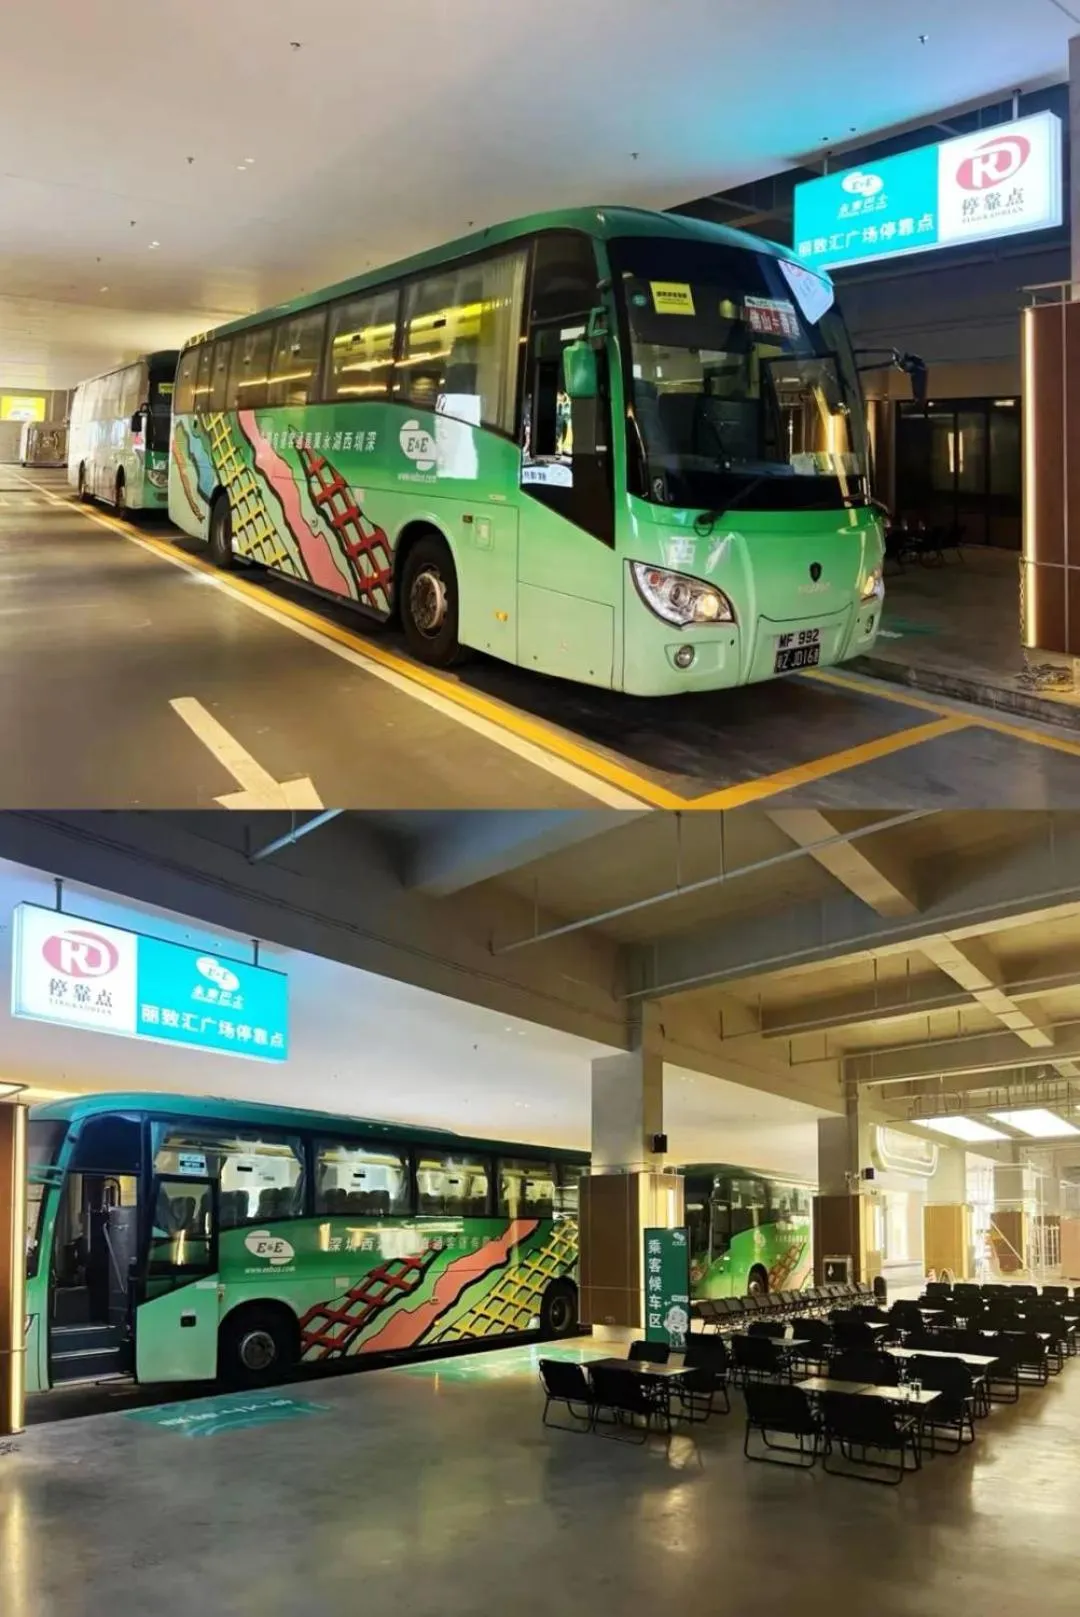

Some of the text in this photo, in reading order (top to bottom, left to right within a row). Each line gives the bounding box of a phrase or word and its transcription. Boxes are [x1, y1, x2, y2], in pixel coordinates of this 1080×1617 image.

[962, 187, 1024, 216] 停靠点
[798, 213, 934, 257] 丽致汇广场停靠点
[798, 628, 820, 645] 992
[49, 978, 113, 1008] 停靠点
[141, 1003, 284, 1048] 丽致汇广场停靠点
[648, 1238, 662, 1328] 乘客候车区
